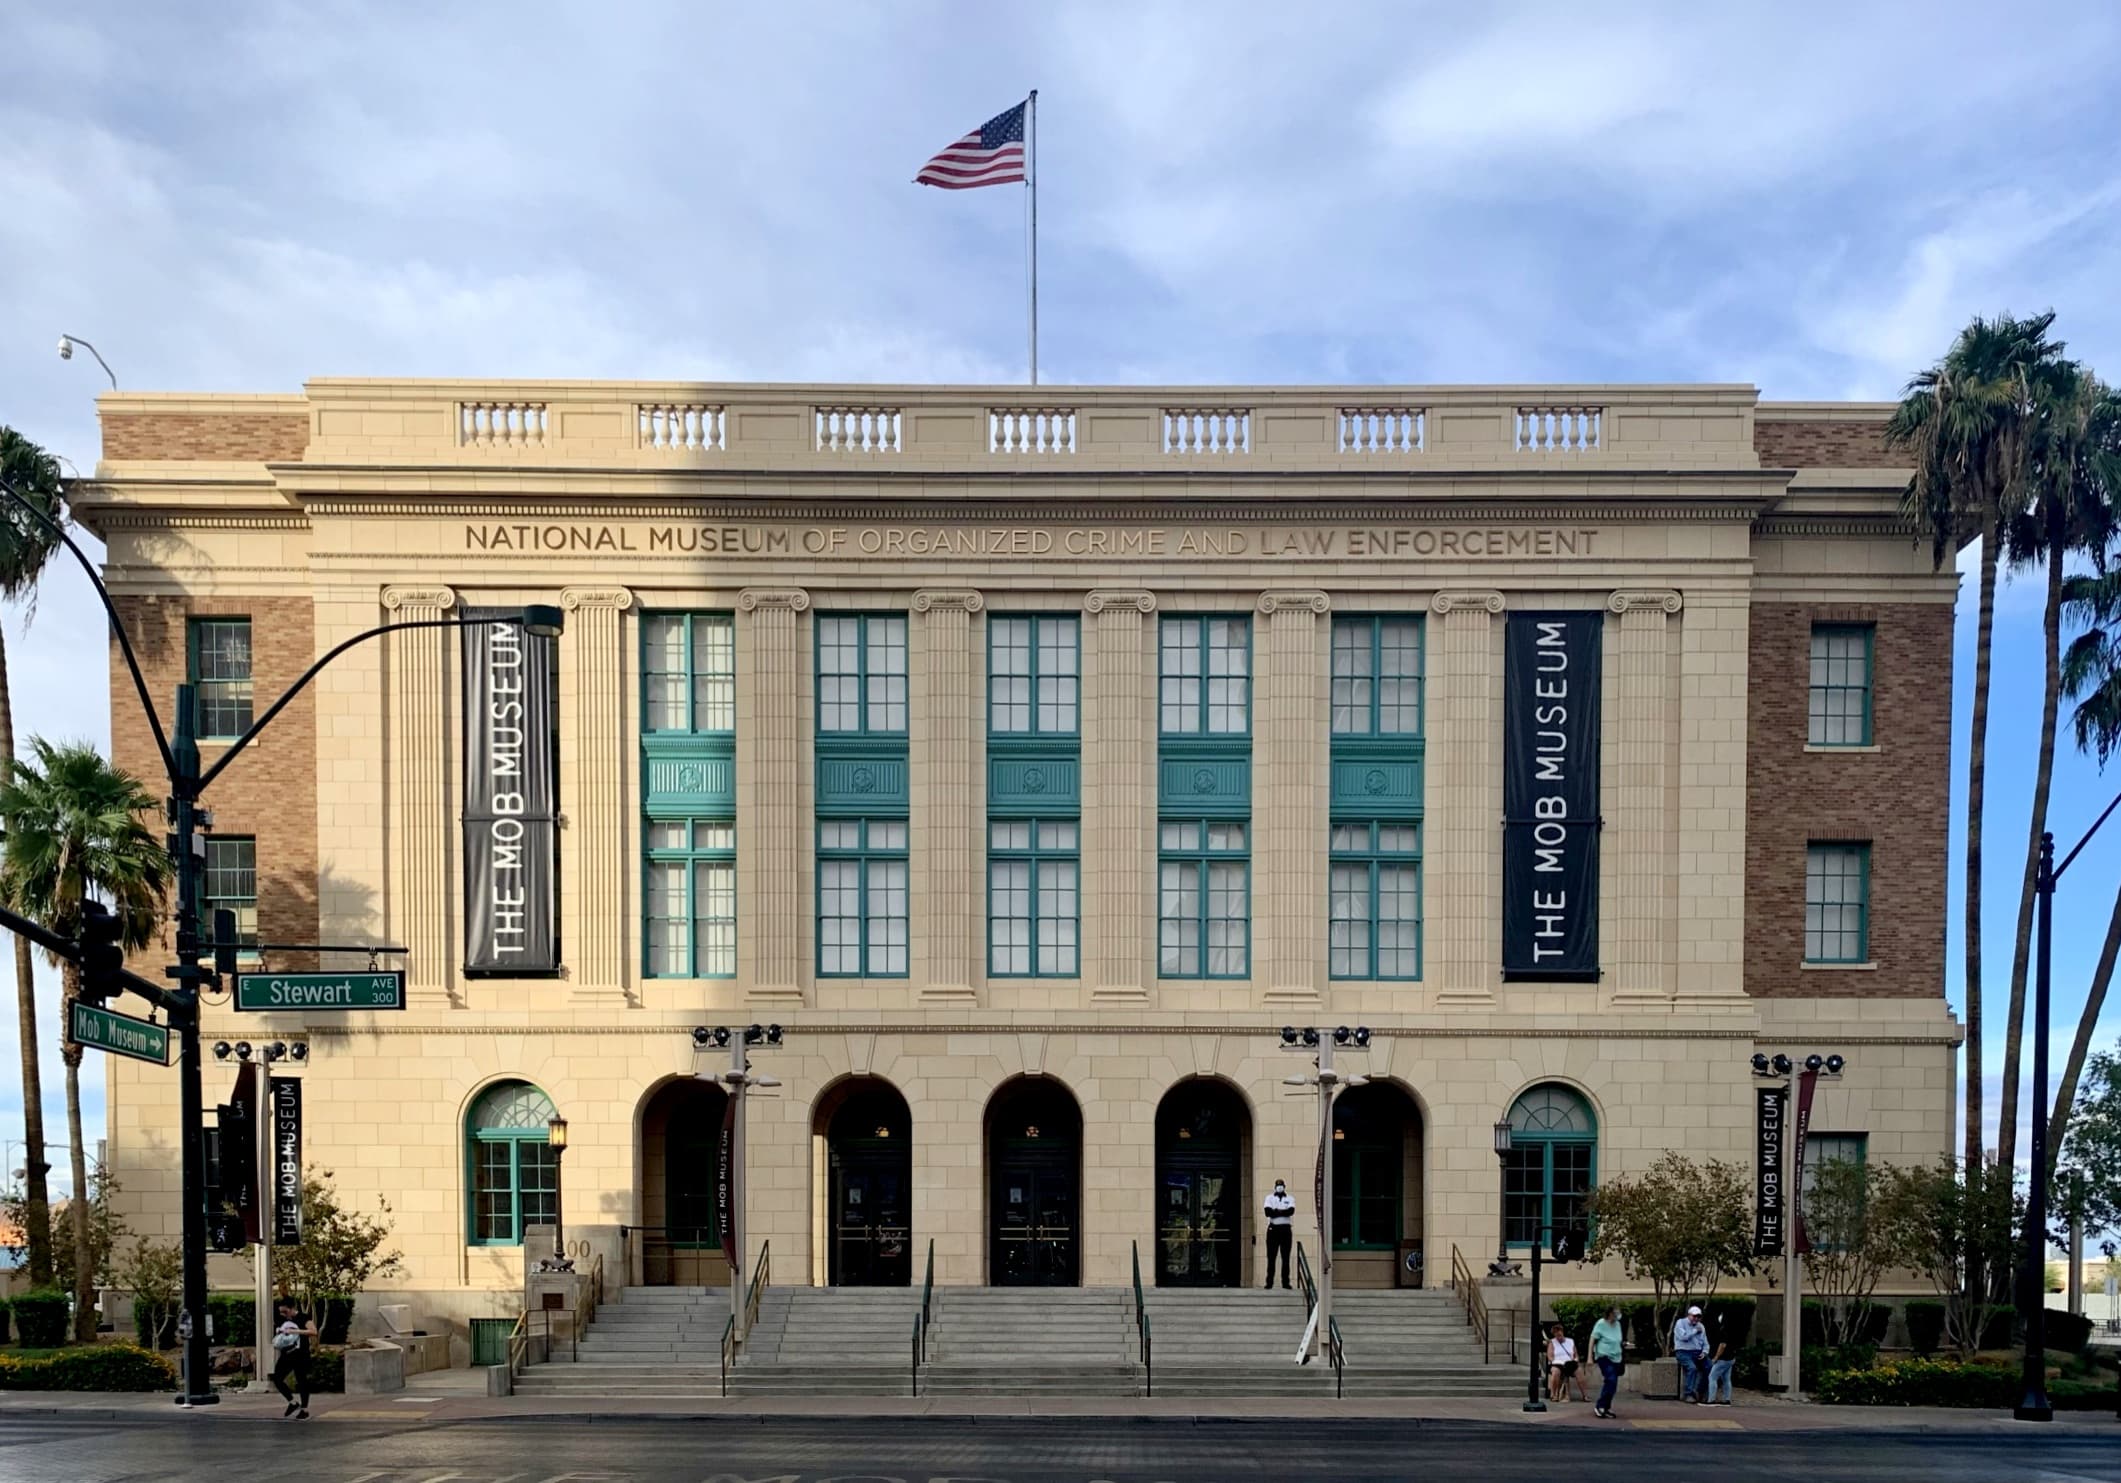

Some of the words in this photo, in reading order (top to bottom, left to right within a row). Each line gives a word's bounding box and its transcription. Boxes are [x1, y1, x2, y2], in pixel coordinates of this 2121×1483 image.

[466, 526, 636, 552] NATIONAL
[649, 527, 790, 553] MUSEUM
[803, 528, 846, 553] OF
[859, 528, 1052, 554] ORGANIZED
[1064, 529, 1166, 555] CRIME
[1177, 529, 1249, 555] AND
[1261, 529, 1336, 555] LAW
[1347, 530, 1598, 556] ENFORCEMENT
[490, 622, 523, 776] MUSEUM
[1535, 622, 1568, 780] MUSEUM
[491, 792, 524, 869] MOB
[1534, 796, 1567, 872] MOB
[493, 886, 525, 960] THE
[1533, 889, 1566, 963] THE
[243, 980, 250, 991] E
[270, 979, 352, 1004] Stewart
[371, 978, 394, 989] AVE
[372, 992, 393, 1004] 300
[78, 1011, 100, 1040] Mob
[108, 1018, 147, 1053] Museum
[280, 1083, 297, 1156] MUSEUM
[1763, 1094, 1778, 1167] MUSEUM
[719, 1130, 728, 1180] MUSEUM
[281, 1161, 297, 1198] MOB
[719, 1183, 727, 1208] MOB
[1763, 1172, 1778, 1208] MOB
[282, 1204, 297, 1238] THE
[720, 1212, 728, 1235] THE
[1761, 1215, 1777, 1248] THE
[567, 1240, 591, 1258] 00
